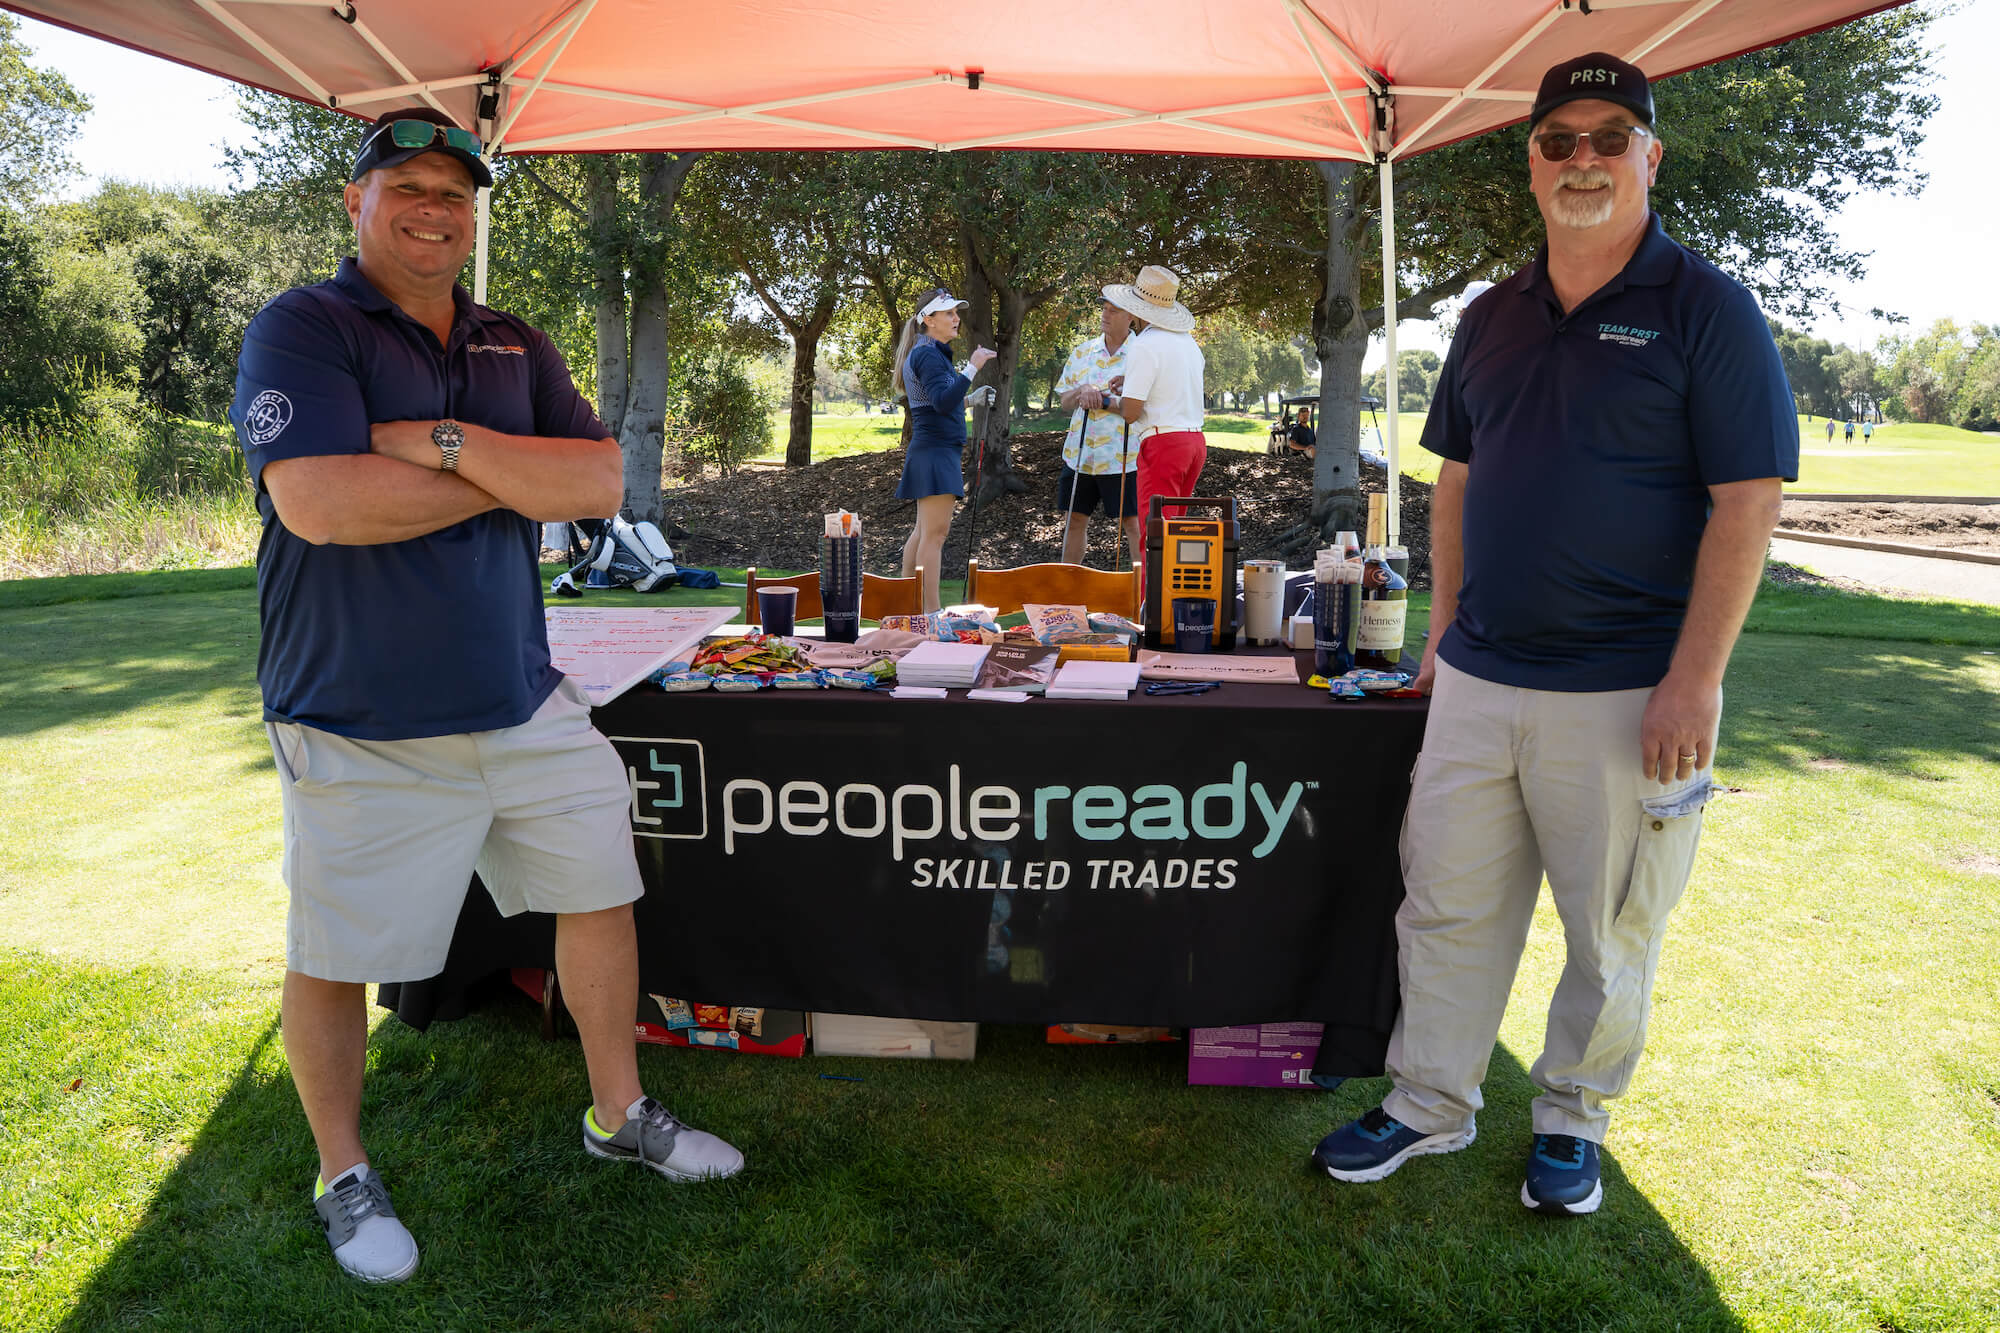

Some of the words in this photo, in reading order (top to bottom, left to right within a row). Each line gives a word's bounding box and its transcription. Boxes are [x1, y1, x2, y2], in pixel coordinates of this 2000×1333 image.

[1570, 68, 1619, 86] PRST
[1599, 323, 1630, 335] TEAM
[1630, 327, 1661, 340] PRST
[248, 394, 284, 417] RESPECT
[261, 418, 286, 441] CRAFT
[723, 761, 1304, 860] peopleready
[911, 857, 1071, 891] SKILLED
[1086, 858, 1239, 891] TRADES
